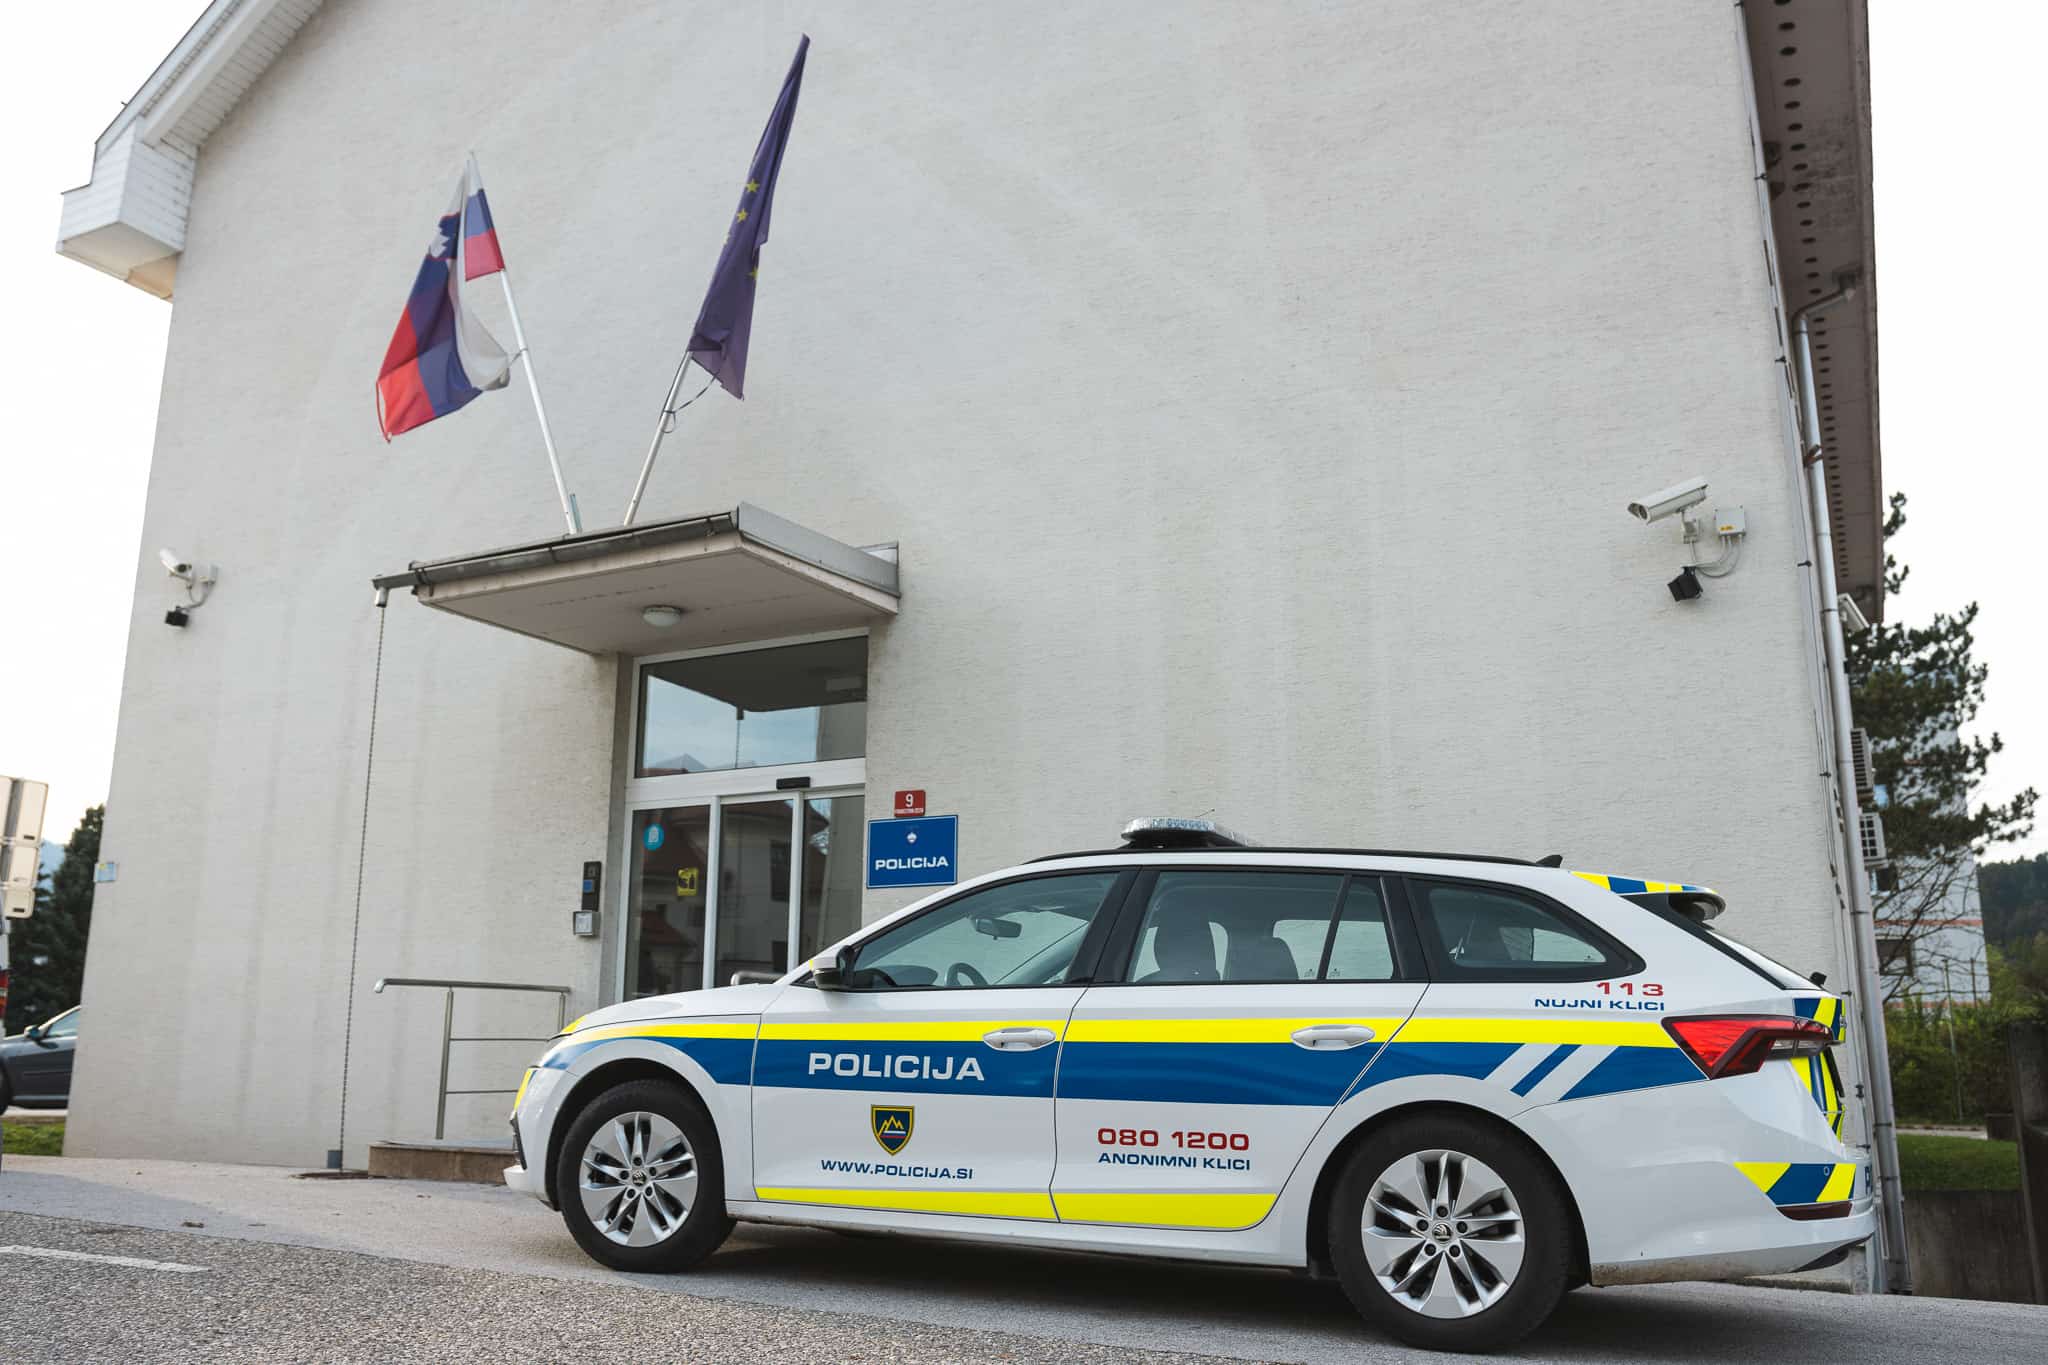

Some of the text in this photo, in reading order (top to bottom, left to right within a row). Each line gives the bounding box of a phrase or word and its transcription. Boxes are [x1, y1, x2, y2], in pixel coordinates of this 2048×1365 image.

[905, 793, 914, 807] 9
[875, 855, 949, 871] POLICIJA
[1597, 982, 1664, 996] 113
[1535, 998, 1664, 1011] NUJNI KLICI
[808, 1052, 985, 1081] POLICIJA
[1097, 1127, 1249, 1151] 080 1200
[821, 1160, 973, 1179] WWW.POLICIJA.SI
[1099, 1153, 1250, 1170] ANONIMNI KLICI
